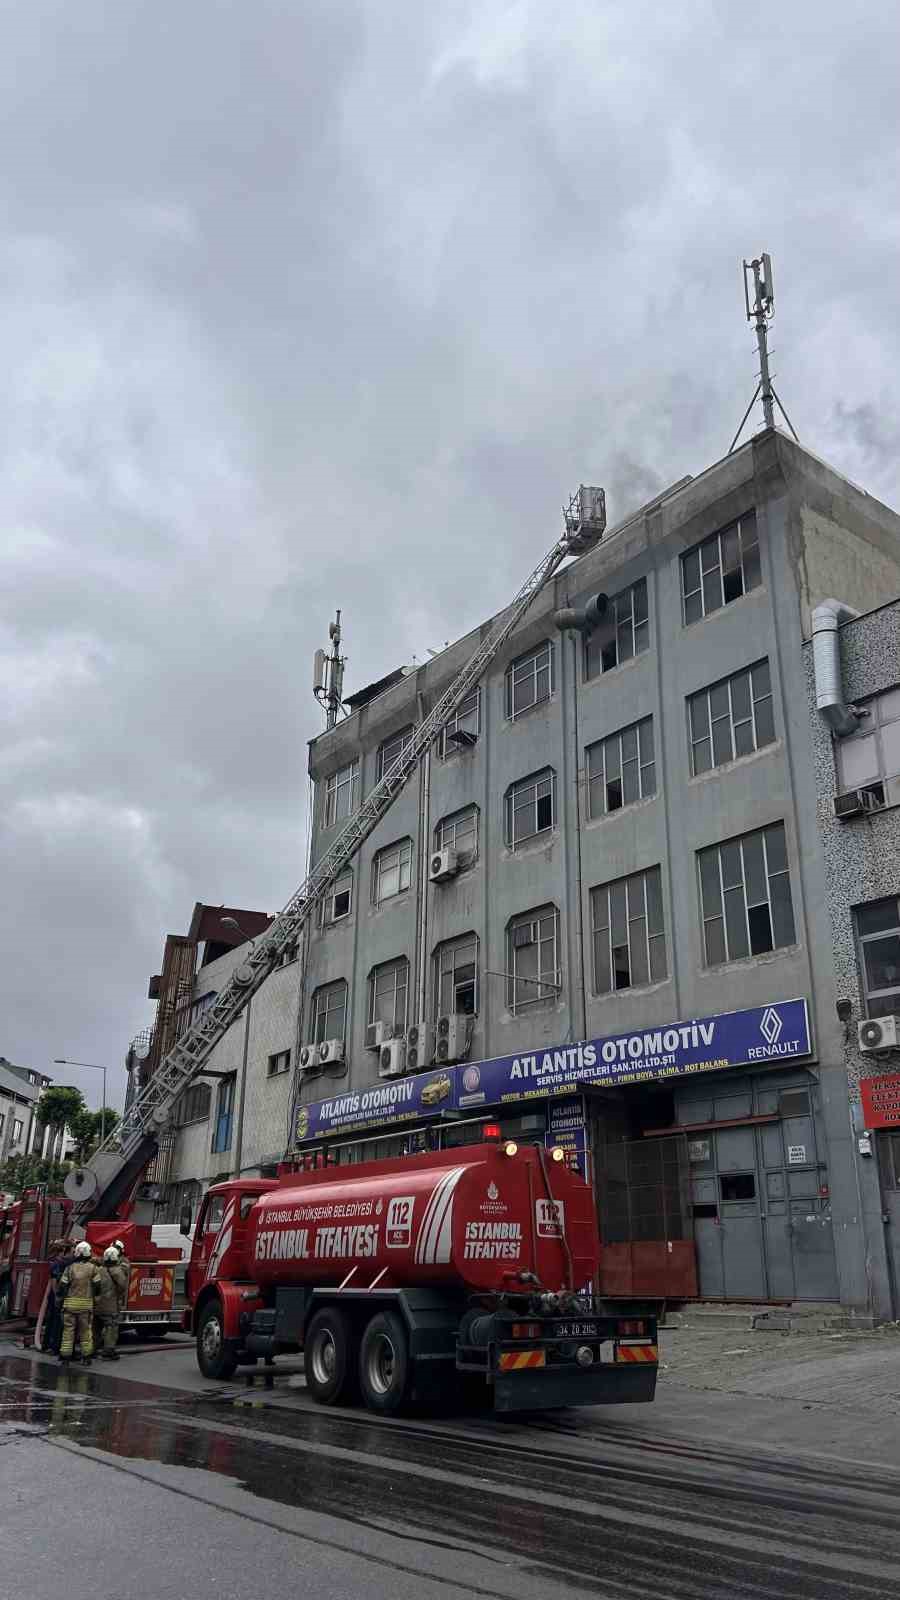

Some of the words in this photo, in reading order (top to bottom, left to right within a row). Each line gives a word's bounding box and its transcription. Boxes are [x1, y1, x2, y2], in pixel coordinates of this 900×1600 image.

[510, 1042, 597, 1080] ATLANTİS
[602, 1020, 715, 1063] OTOMOTİV
[748, 1040, 800, 1059] RENAULT
[537, 1072, 563, 1086] SERVİS
[636, 1070, 653, 1080] BOYA
[685, 1063, 698, 1072] ROT
[700, 1059, 728, 1070] BALANS
[320, 1093, 359, 1120] ATLANTİS
[362, 1080, 414, 1110] OTOMOTİV
[873, 1102, 900, 1112] KAPO
[391, 1202, 410, 1225] 112
